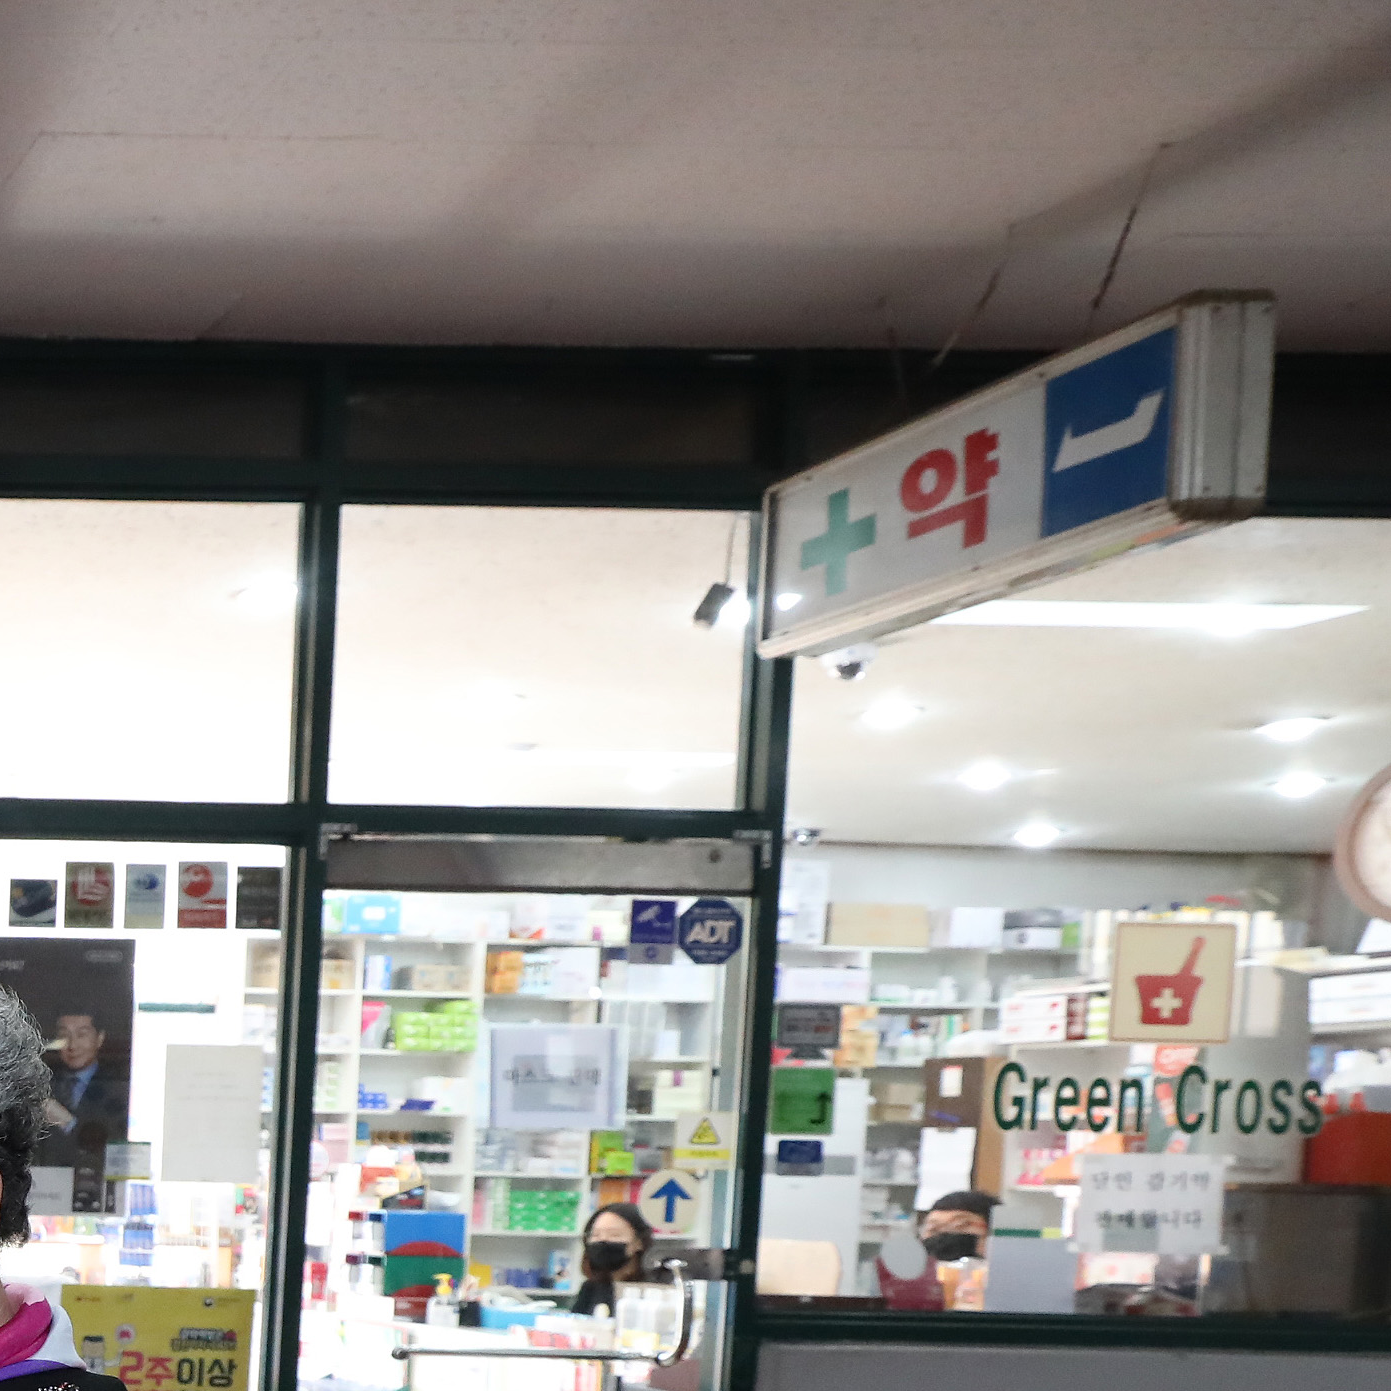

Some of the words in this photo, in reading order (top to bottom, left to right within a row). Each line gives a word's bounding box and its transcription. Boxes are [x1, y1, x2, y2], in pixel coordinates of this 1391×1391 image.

[899, 427, 1000, 549] 약
[685, 919, 737, 944] ADT
[993, 1063, 1146, 1134] Green
[1176, 1066, 1323, 1136] Cross
